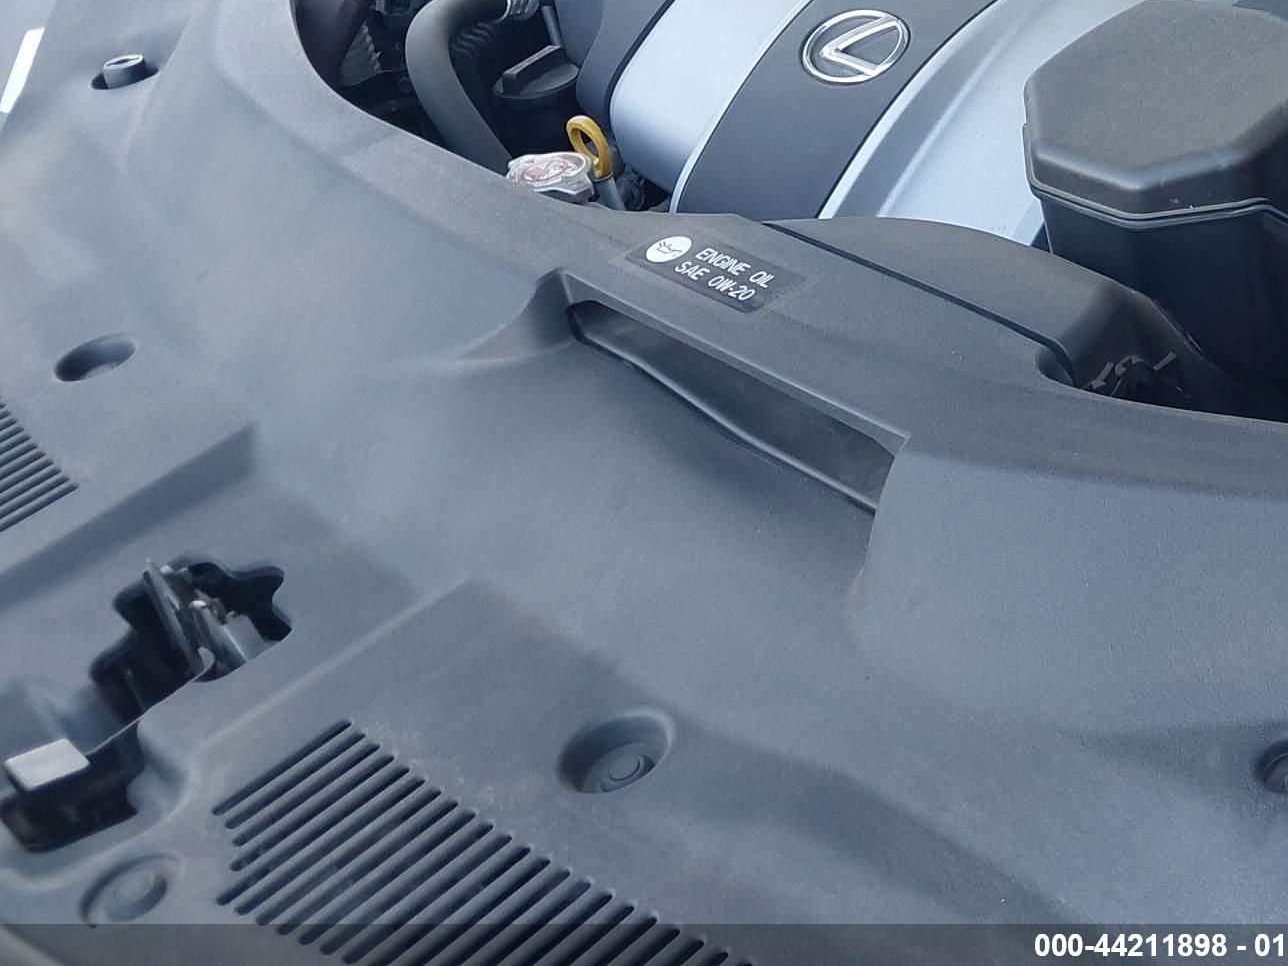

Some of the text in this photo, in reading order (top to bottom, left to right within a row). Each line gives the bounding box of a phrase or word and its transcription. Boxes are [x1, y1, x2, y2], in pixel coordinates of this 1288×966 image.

[674, 261, 711, 281] SAE
[695, 247, 775, 289] ENGINE OIL
